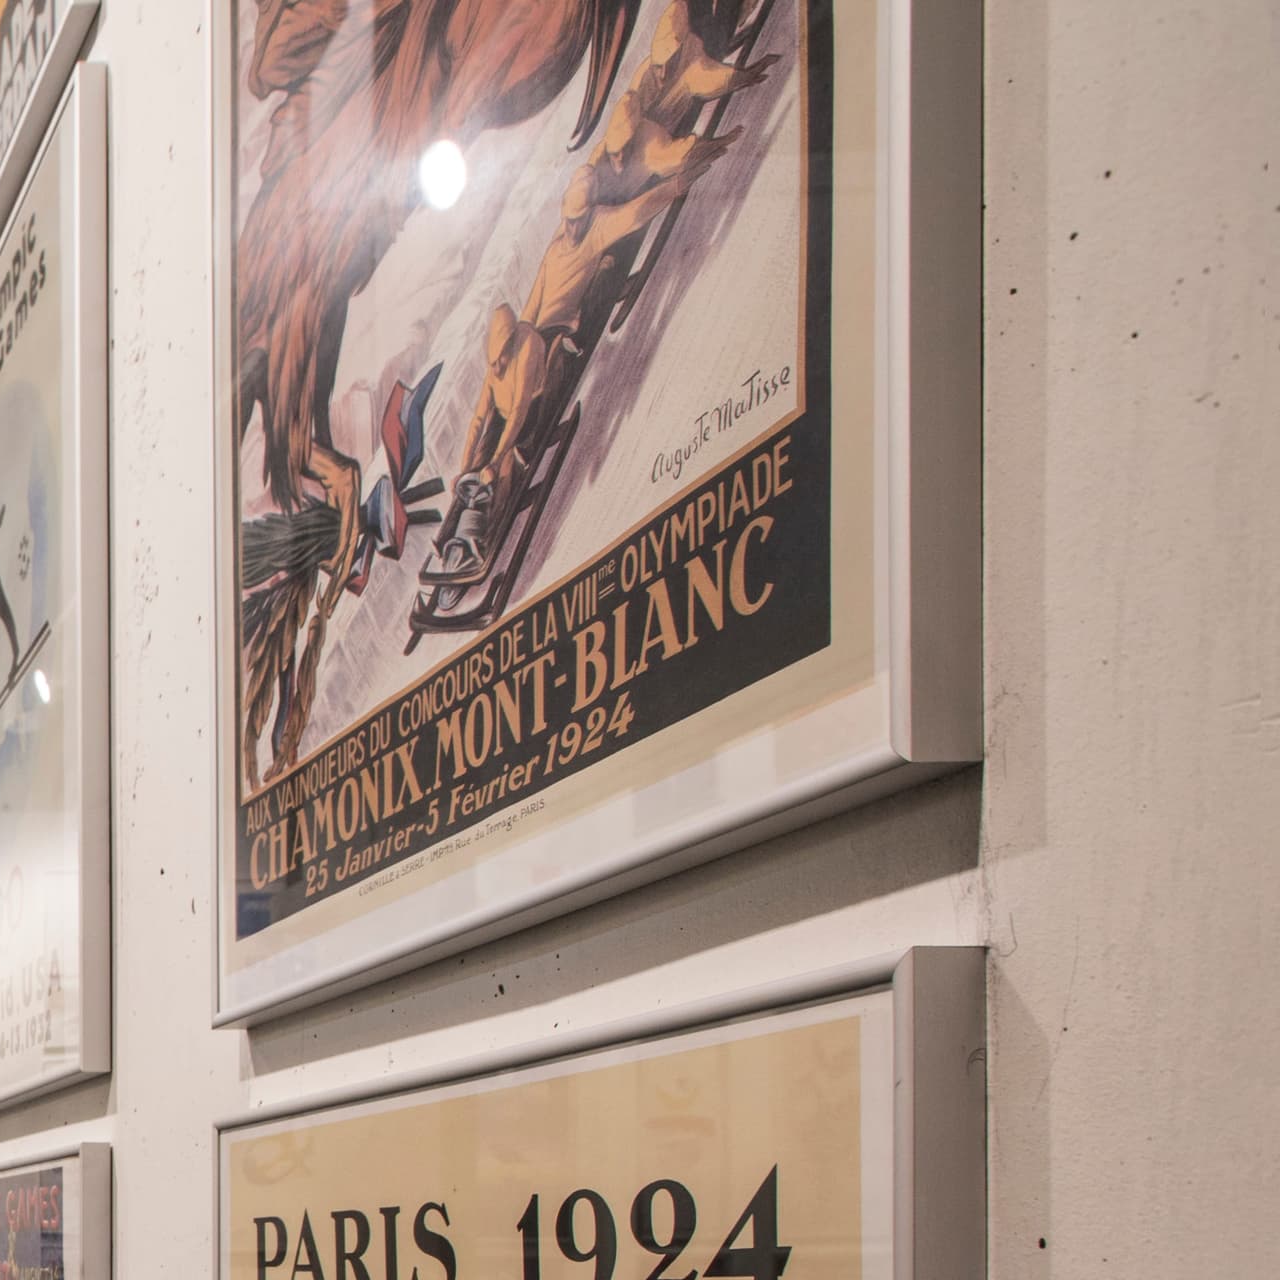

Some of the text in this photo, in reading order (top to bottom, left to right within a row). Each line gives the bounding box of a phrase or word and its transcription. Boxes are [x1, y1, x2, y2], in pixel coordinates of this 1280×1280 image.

[246, 797, 274, 836] AUX
[275, 738, 366, 813] VAINQUEURS
[369, 718, 391, 756] DU
[398, 651, 495, 737] CONCOURS
[500, 634, 527, 676] DE
[532, 610, 559, 657] LA
[620, 436, 793, 592] OLYMPIADE
[306, 858, 328, 897] 25
[446, 758, 535, 826] Février
[542, 691, 637, 776] 1924
[519, 798, 545, 819] PARIS
[6, 1184, 61, 1232] GAMES
